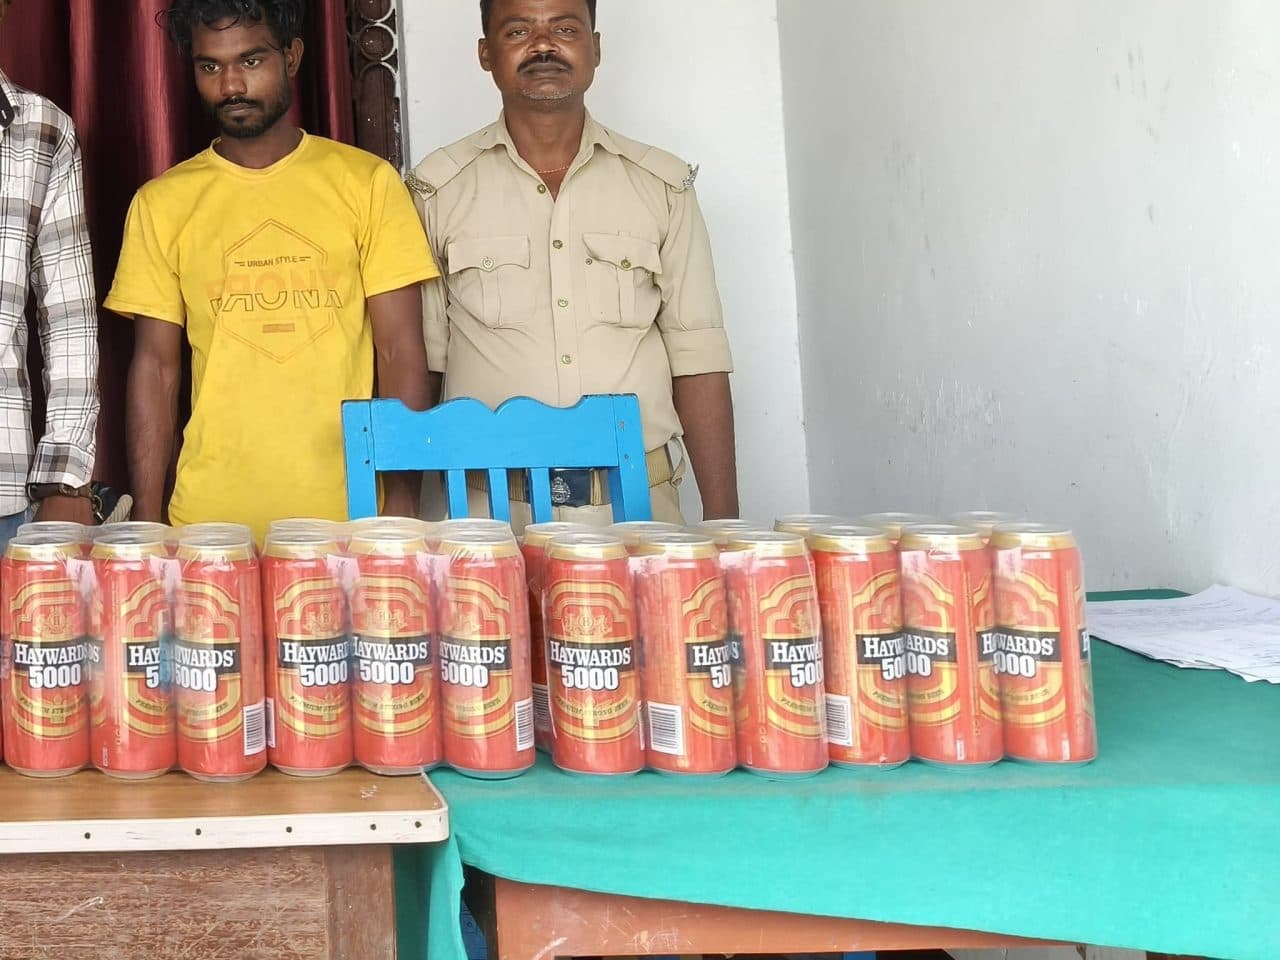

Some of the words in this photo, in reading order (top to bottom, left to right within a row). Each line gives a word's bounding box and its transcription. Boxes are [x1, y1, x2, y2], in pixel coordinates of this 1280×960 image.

[247, 258, 273, 268] URBAN
[275, 255, 298, 265] STYLE
[550, 641, 631, 666] HAYWARDS
[28, 663, 81, 689] 5000
[175, 663, 217, 692] 5000
[300, 660, 348, 687] 5000
[360, 659, 414, 684] 5000
[441, 660, 488, 688] 5000
[561, 665, 619, 690] 5000
